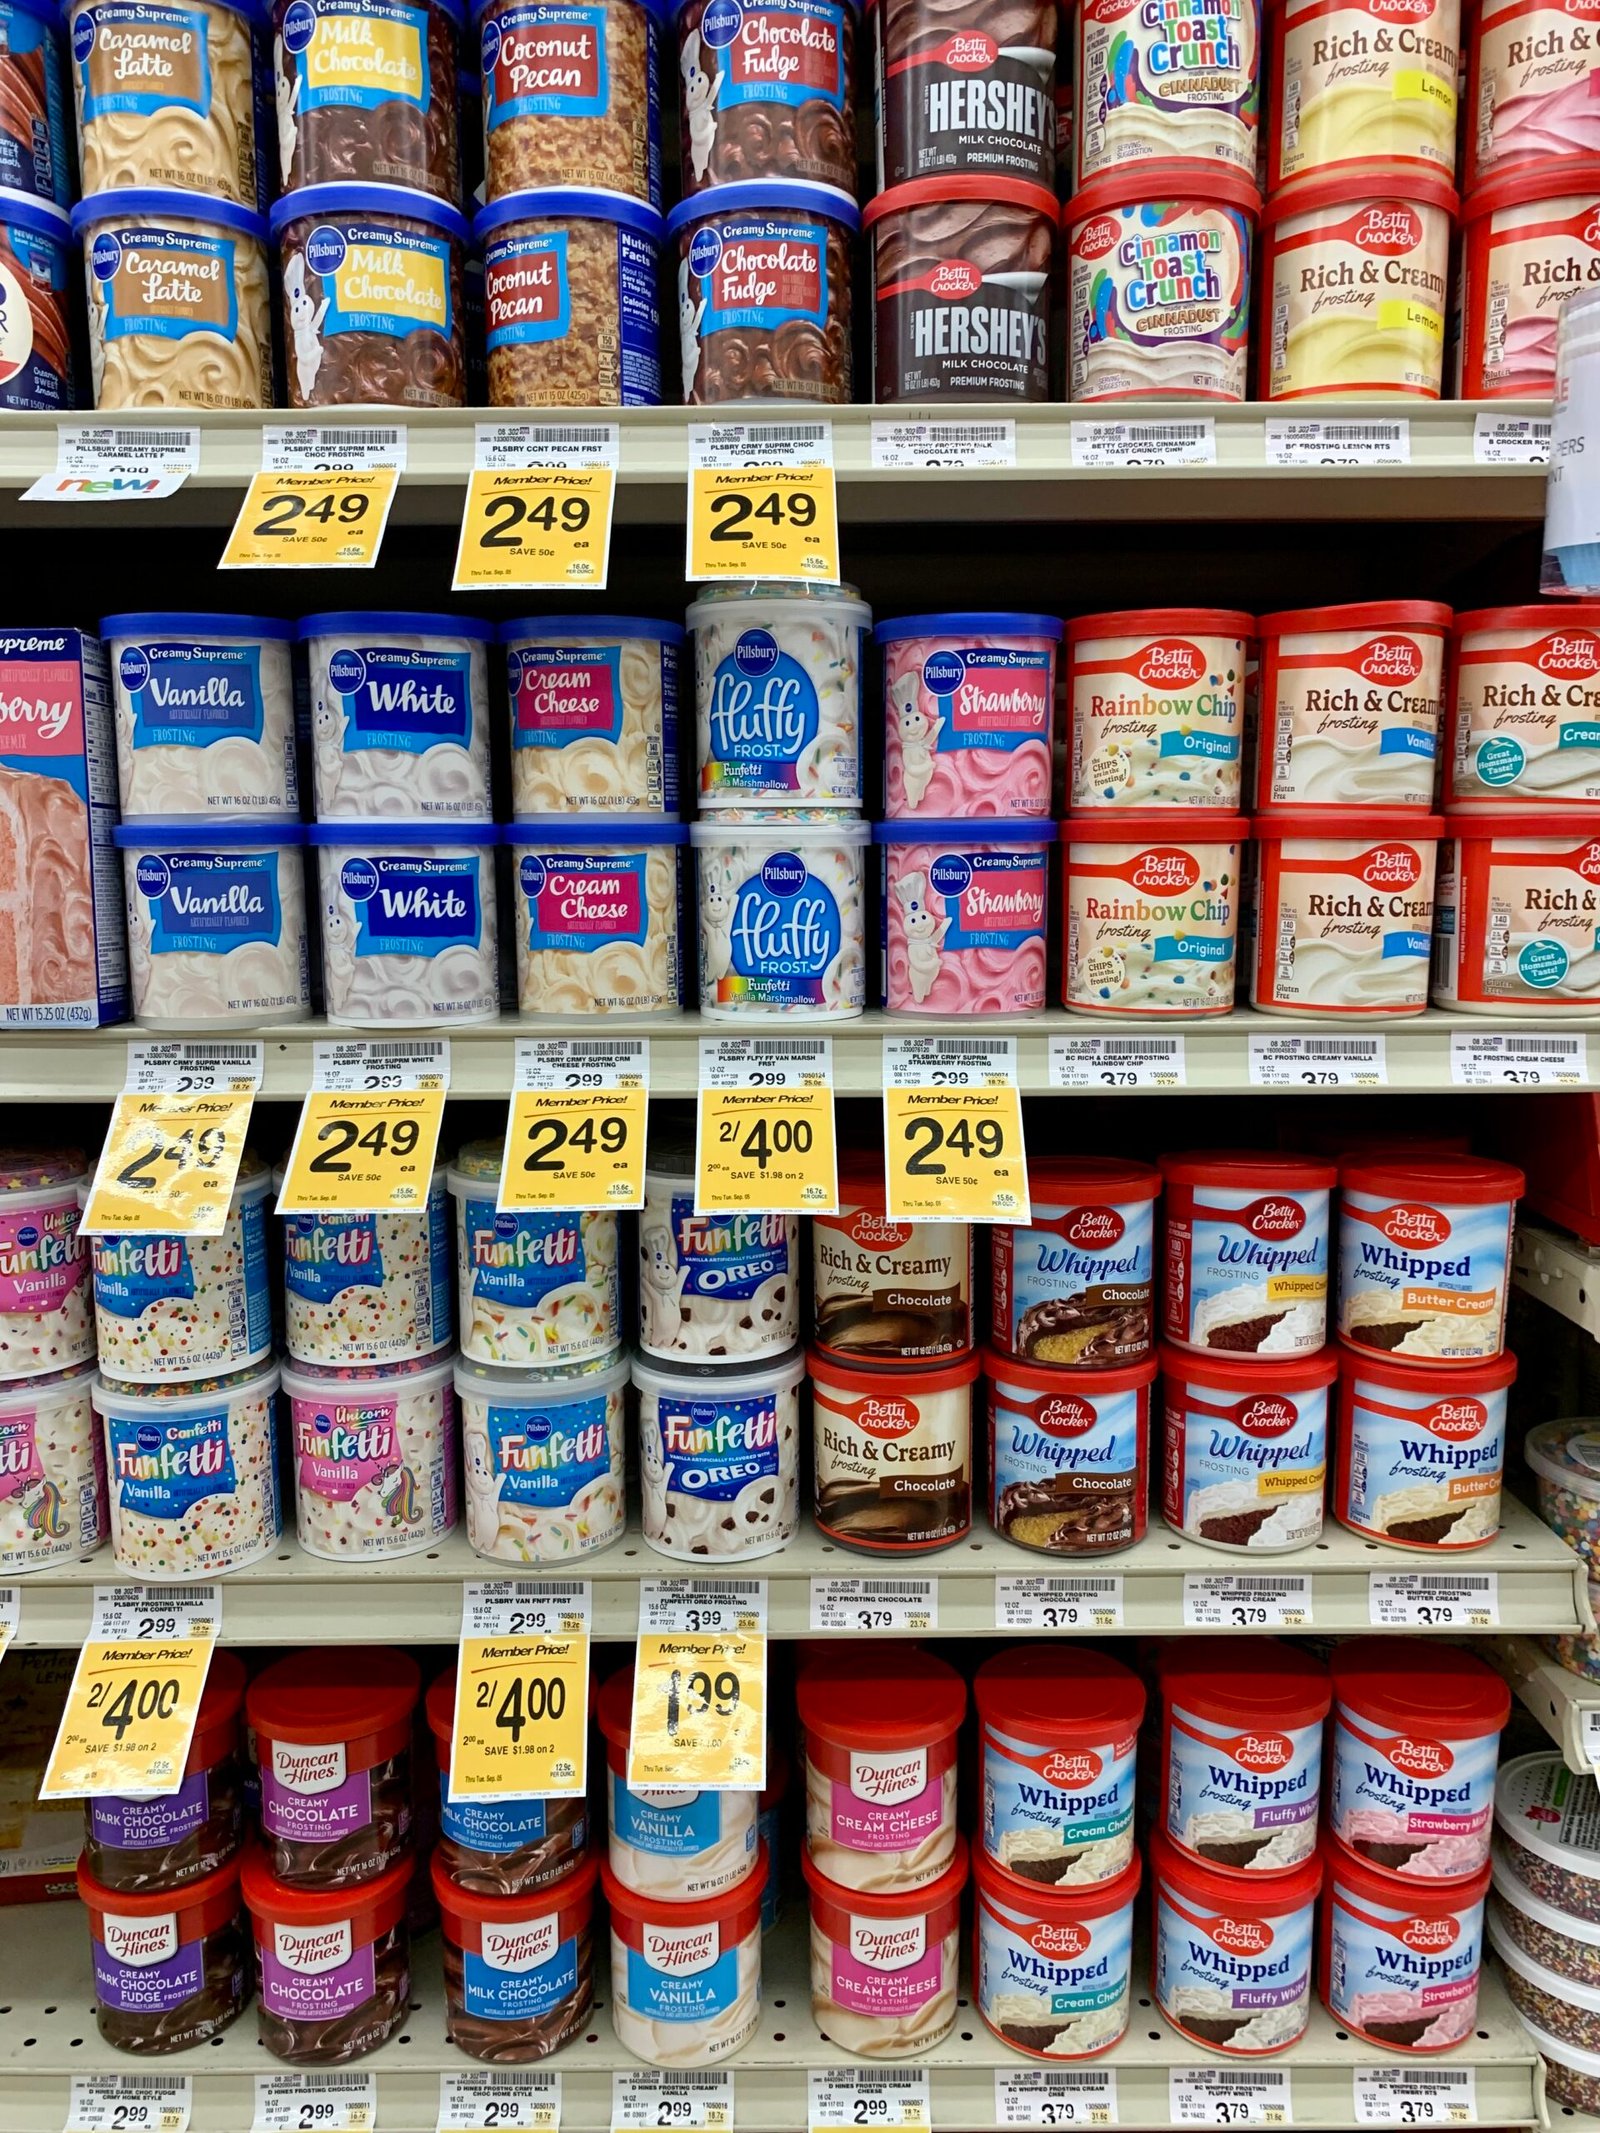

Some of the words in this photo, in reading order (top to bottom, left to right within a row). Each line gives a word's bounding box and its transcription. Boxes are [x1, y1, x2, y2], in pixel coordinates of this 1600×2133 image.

[501, 7, 536, 28] Creamy
[538, 7, 587, 23] Supreme
[501, 35, 591, 65] Coconut
[511, 63, 581, 93] Pecan
[1366, 209, 1410, 230] Betty
[122, 232, 166, 247] Creamy
[168, 234, 217, 251] Supreme
[1355, 228, 1418, 247] Crocker
[308, 243, 345, 260] Pillsbury
[691, 242, 720, 262] Pillsbury
[721, 246, 817, 273] Chocolate
[126, 251, 219, 281] Caramel
[352, 249, 405, 275] Milk
[1141, 250, 1206, 280] Toast
[938, 266, 970, 282] Betty
[1301, 262, 1355, 293] Rich
[1360, 260, 1380, 284] &
[143, 273, 203, 304] Latte
[344, 275, 442, 311] Chocolate
[723, 276, 777, 303] Fudge
[930, 279, 977, 293] Crocker
[1128, 276, 1221, 307] Crunch
[1312, 289, 1375, 312] frosting
[348, 313, 395, 330] FROSTING
[723, 310, 764, 325] FROSTING
[1136, 308, 1221, 332] CINNADUST
[1407, 308, 1439, 332] Lemon
[915, 306, 1047, 365] HERSHEY'S
[1164, 324, 1202, 336] FROSTING
[943, 360, 969, 369] MILK
[971, 360, 1029, 374] CHOCOLATE
[950, 376, 985, 386] PREMIUM
[987, 378, 1025, 390] FROSTING
[76, 445, 116, 453] PILLSBURY
[492, 445, 524, 453] PLSBRY
[552, 445, 580, 453] PECAN
[582, 445, 602, 453] FRST
[757, 447, 794, 455] FROSTING
[56, 478, 160, 494] new!
[716, 473, 773, 484] Member
[776, 473, 813, 483] Price!
[742, 541, 768, 550] SAVE
[804, 536, 820, 544] ea
[966, 651, 1007, 665] Creamy
[1150, 648, 1193, 668] Betty
[329, 663, 364, 678] Pillsbury
[925, 665, 963, 680] Pillsbury
[1139, 664, 1200, 680] Crocker
[366, 680, 456, 715] White
[959, 684, 1046, 724] Strawberry
[1091, 693, 1193, 717] Rainbow
[1196, 694, 1237, 722] Chip
[1100, 719, 1157, 739] frosting
[366, 733, 411, 748] FROSTING
[1184, 735, 1232, 758] Original
[1092, 760, 1118, 772] CHIPS
[169, 857, 212, 870] Creamy
[214, 857, 264, 870] Supreme
[764, 867, 805, 882] Pillsbury
[549, 875, 619, 896] Cream
[169, 885, 265, 915] Vanilla
[560, 897, 628, 919] Cheese
[1308, 894, 1362, 919] Rich
[1367, 895, 1386, 917] &
[733, 893, 829, 972] fluffy
[1321, 920, 1381, 938] frosting
[172, 936, 216, 950] FROSTING
[1530, 952, 1555, 962] Great
[1520, 960, 1567, 972] Homemade
[1530, 967, 1558, 978] Taste!
[747, 978, 790, 992] Funfetti
[1276, 984, 1299, 994] Gluten
[758, 993, 815, 1005] Marshmallow
[1276, 992, 1290, 1000] Free
[7, 1009, 20, 1021] NET
[21, 1009, 35, 1020] WT
[36, 1008, 54, 1020] 15.25
[55, 1008, 67, 1020] OZ
[68, 1007, 92, 1022] (432g)
[722, 1095, 776, 1105] Member
[779, 1095, 813, 1104] Price!
[730, 1171, 755, 1179] SAVE
[760, 1171, 783, 1180] $1.98
[1360, 1242, 1471, 1279] Whipped
[1407, 1292, 1455, 1308] Butter
[1456, 1296, 1495, 1311] Cream
[334, 1405, 392, 1423] Unicorn
[693, 1407, 717, 1418] Pillsbury
[1049, 1399, 1083, 1416] Betty
[1040, 1412, 1092, 1427] Crocker
[166, 1419, 222, 1440] Confetti
[823, 1428, 857, 1458] Rich
[862, 1441, 879, 1460] &
[882, 1438, 956, 1464] Creamy
[1011, 1425, 1116, 1468] Whipped
[117, 1439, 224, 1479] Funfetti
[831, 1454, 877, 1479] frosting
[1004, 1455, 1047, 1474] FROSTING
[312, 1462, 358, 1481] Vanilla
[681, 1462, 760, 1488] OREO
[126, 1484, 171, 1500] Vanilla
[894, 1478, 956, 1491] Chocolate
[1072, 1477, 1131, 1490] Chocolate
[122, 1804, 167, 1815] CREAMY
[1409, 1814, 1471, 1831] Strawberry
[123, 1825, 167, 1839] FUDGE
[279, 1929, 345, 1951] Duncan
[270, 1978, 364, 2001] CHOCOLATE
[661, 1981, 703, 1990] CREAMY
[836, 1976, 883, 1998] CREAM
[887, 1976, 937, 1997] CHEESE
[650, 1988, 717, 2004] VANILLA
[1239, 1990, 1279, 2005] Fluffy
